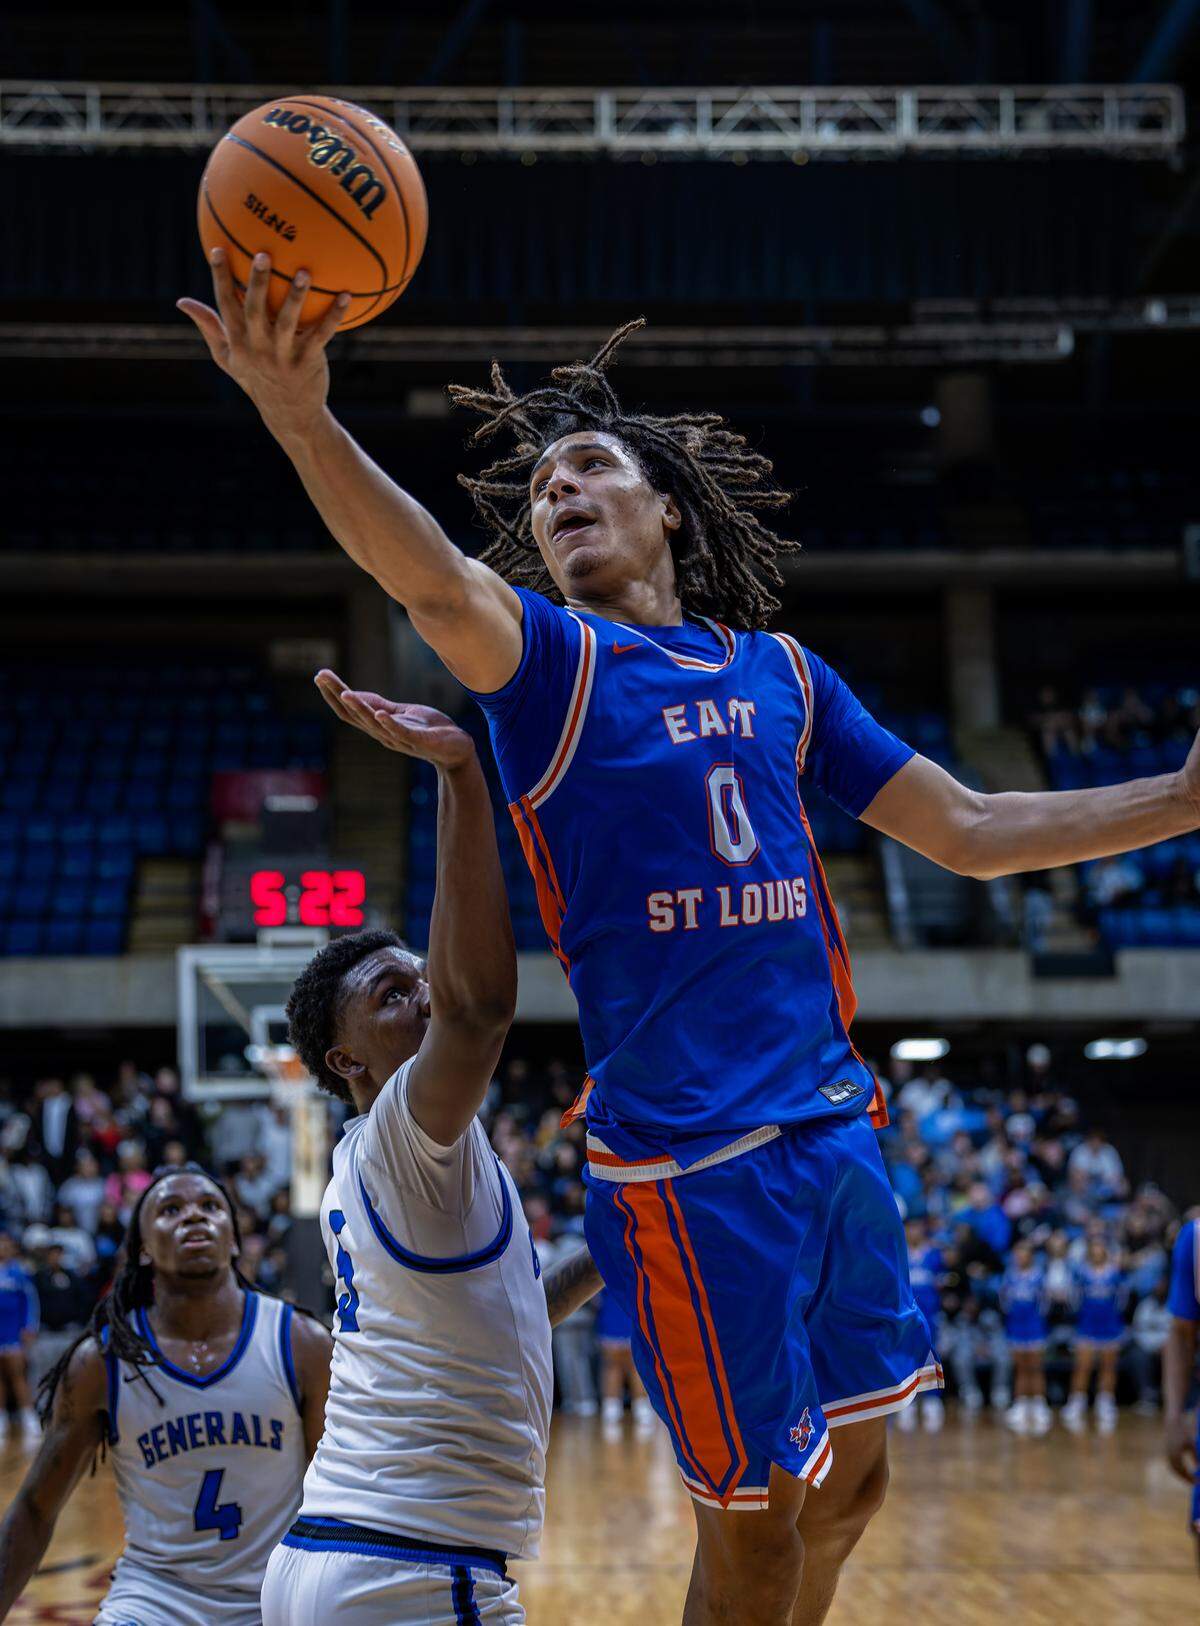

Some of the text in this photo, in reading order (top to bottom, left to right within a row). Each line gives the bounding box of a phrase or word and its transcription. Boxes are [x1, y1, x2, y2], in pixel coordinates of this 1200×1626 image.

[263, 108, 387, 221] Wilson
[243, 193, 288, 235] NFHS
[662, 699, 757, 744] EAST
[703, 761, 760, 867] 0
[647, 877, 807, 932] ST LOUIS
[137, 1411, 284, 1469] GENERALS
[194, 1468, 243, 1541] 4
